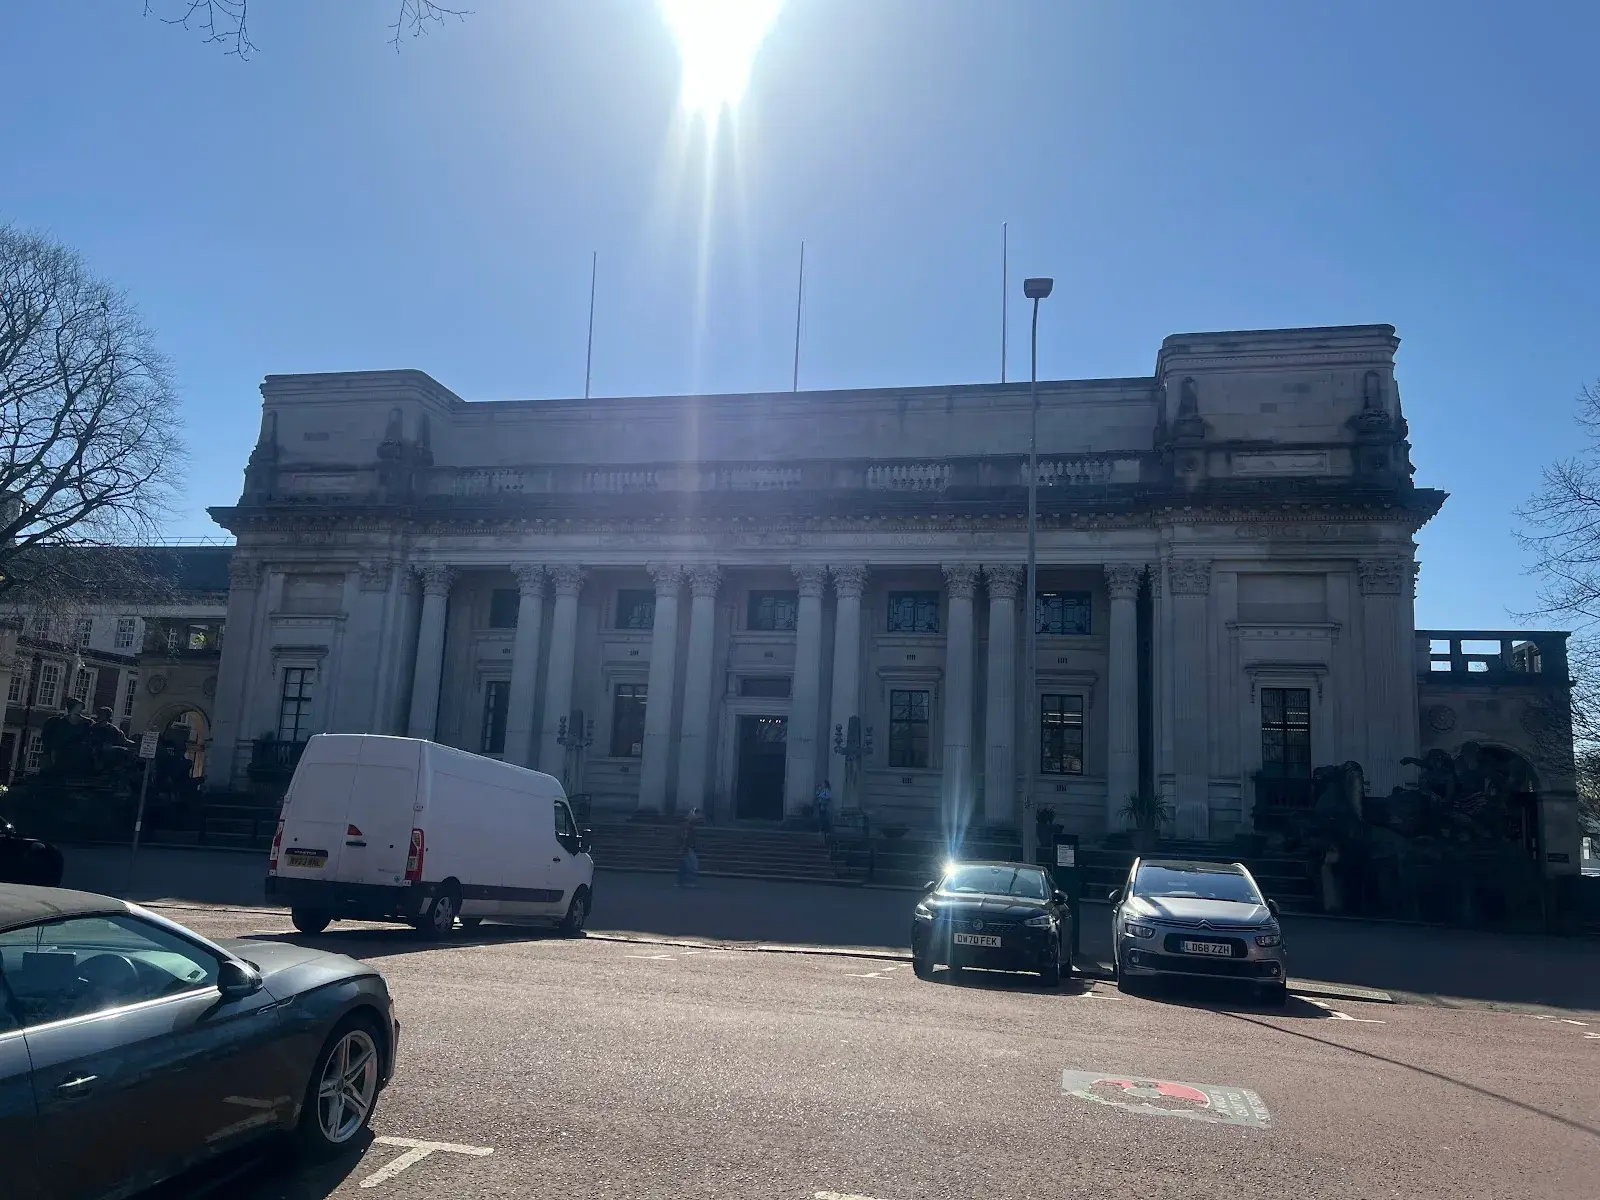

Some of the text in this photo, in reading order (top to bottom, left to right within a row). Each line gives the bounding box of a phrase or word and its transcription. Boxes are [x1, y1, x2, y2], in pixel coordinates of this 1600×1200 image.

[957, 934, 997, 946] DW70 FEK
[1185, 943, 1230, 955] LD68 ZZH
